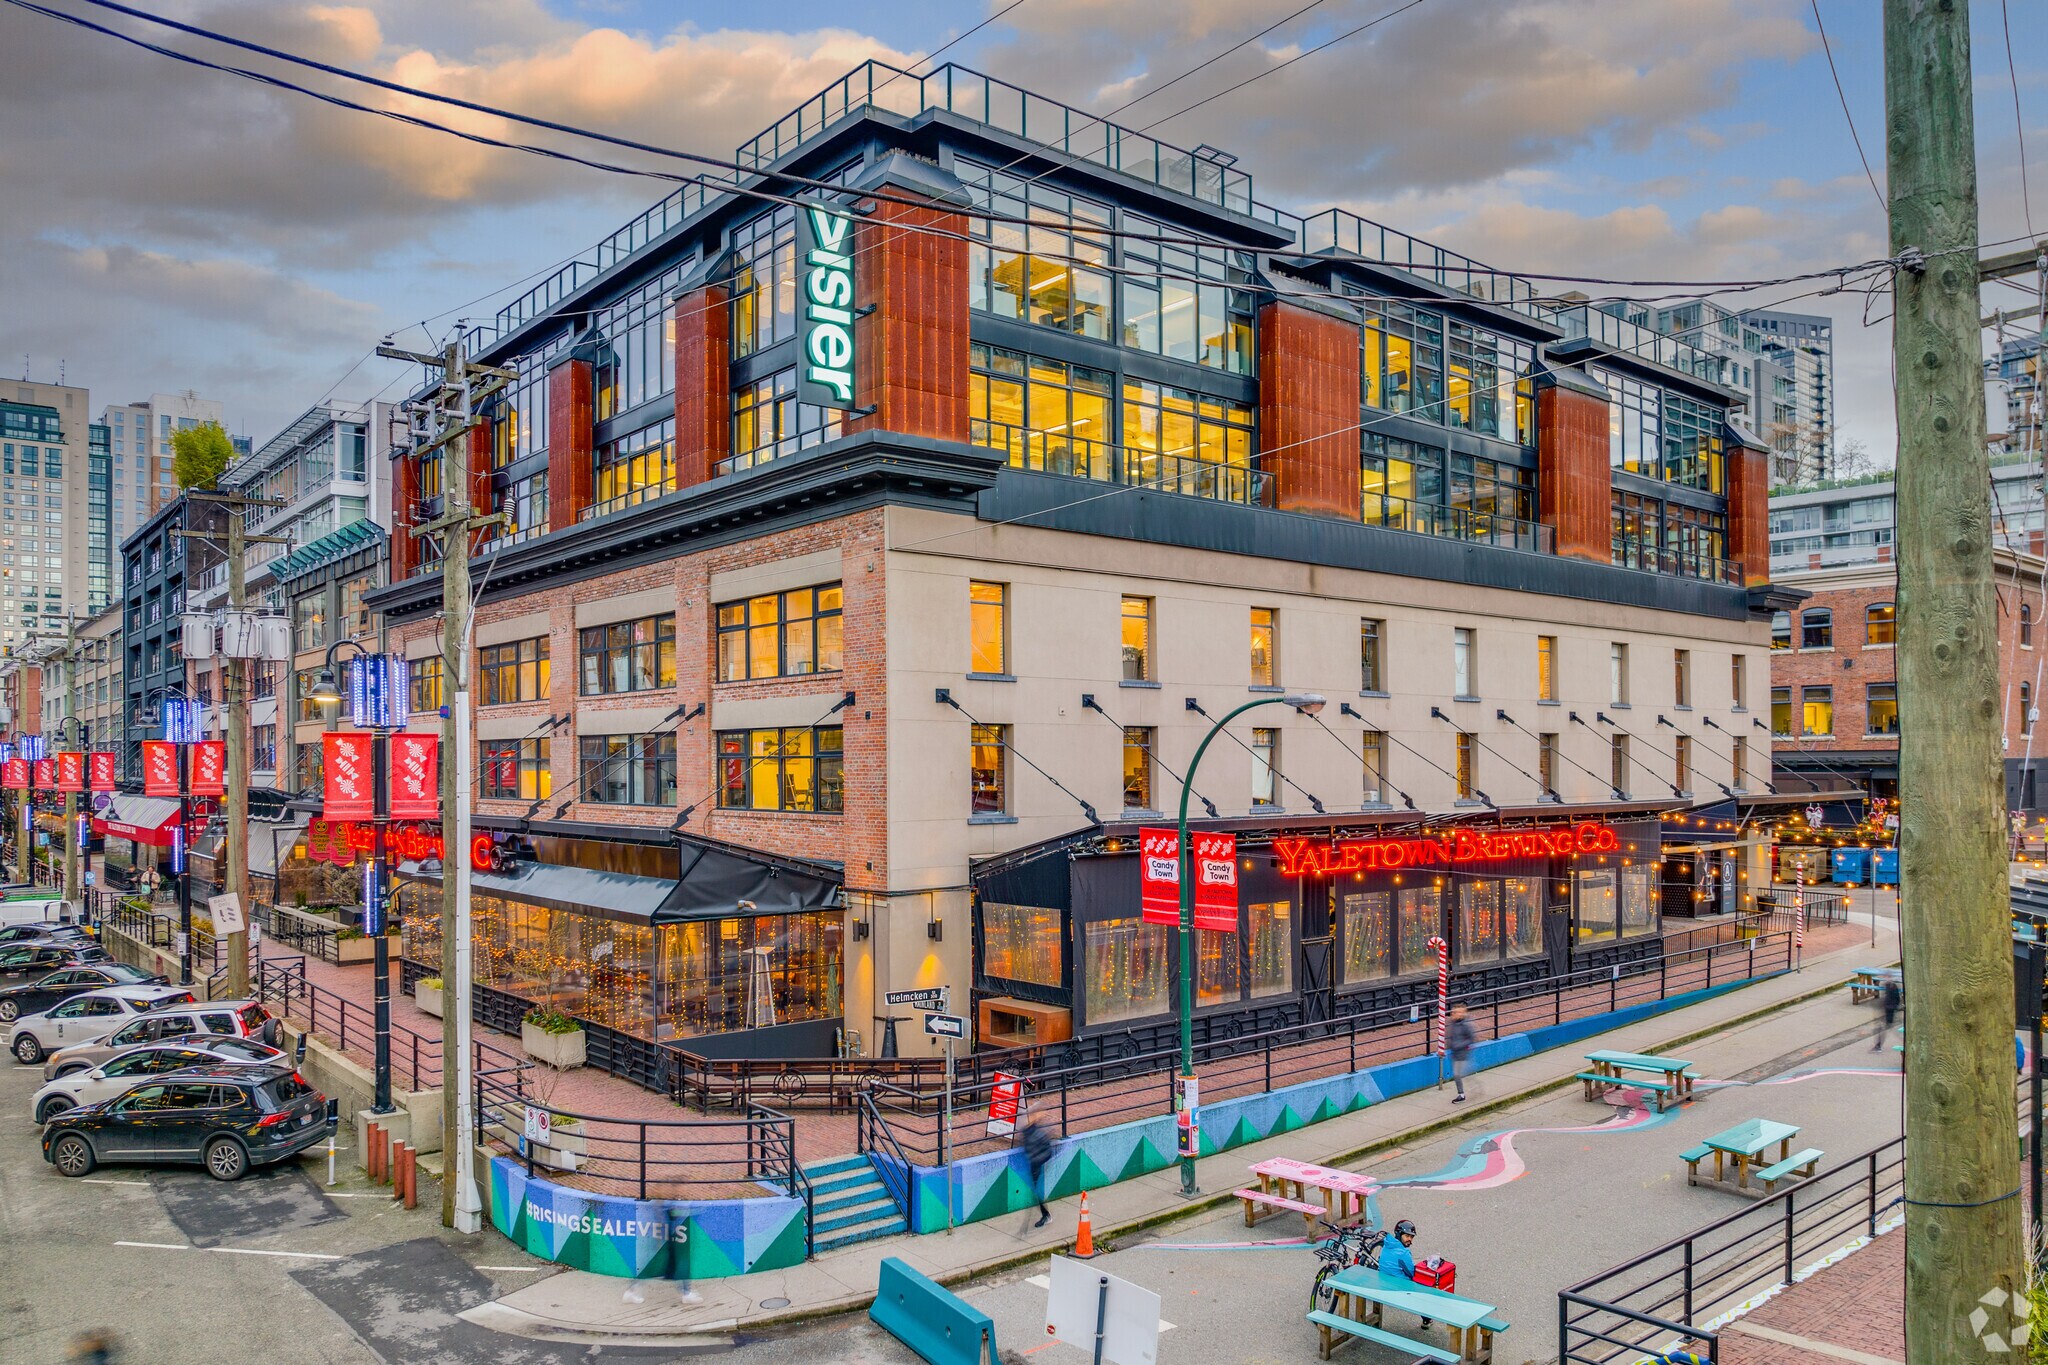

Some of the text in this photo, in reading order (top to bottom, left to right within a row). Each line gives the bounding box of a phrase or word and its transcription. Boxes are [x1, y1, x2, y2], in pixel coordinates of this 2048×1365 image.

[1275, 838, 1451, 875] YALETOWN
[1152, 860, 1175, 871] Candy
[1207, 863, 1230, 874] Candy
[1154, 869, 1173, 878] Town
[1210, 872, 1230, 881] Town
[890, 991, 928, 1003] Helmcken
[526, 1200, 688, 1244] #RISINGSEALEVELS
